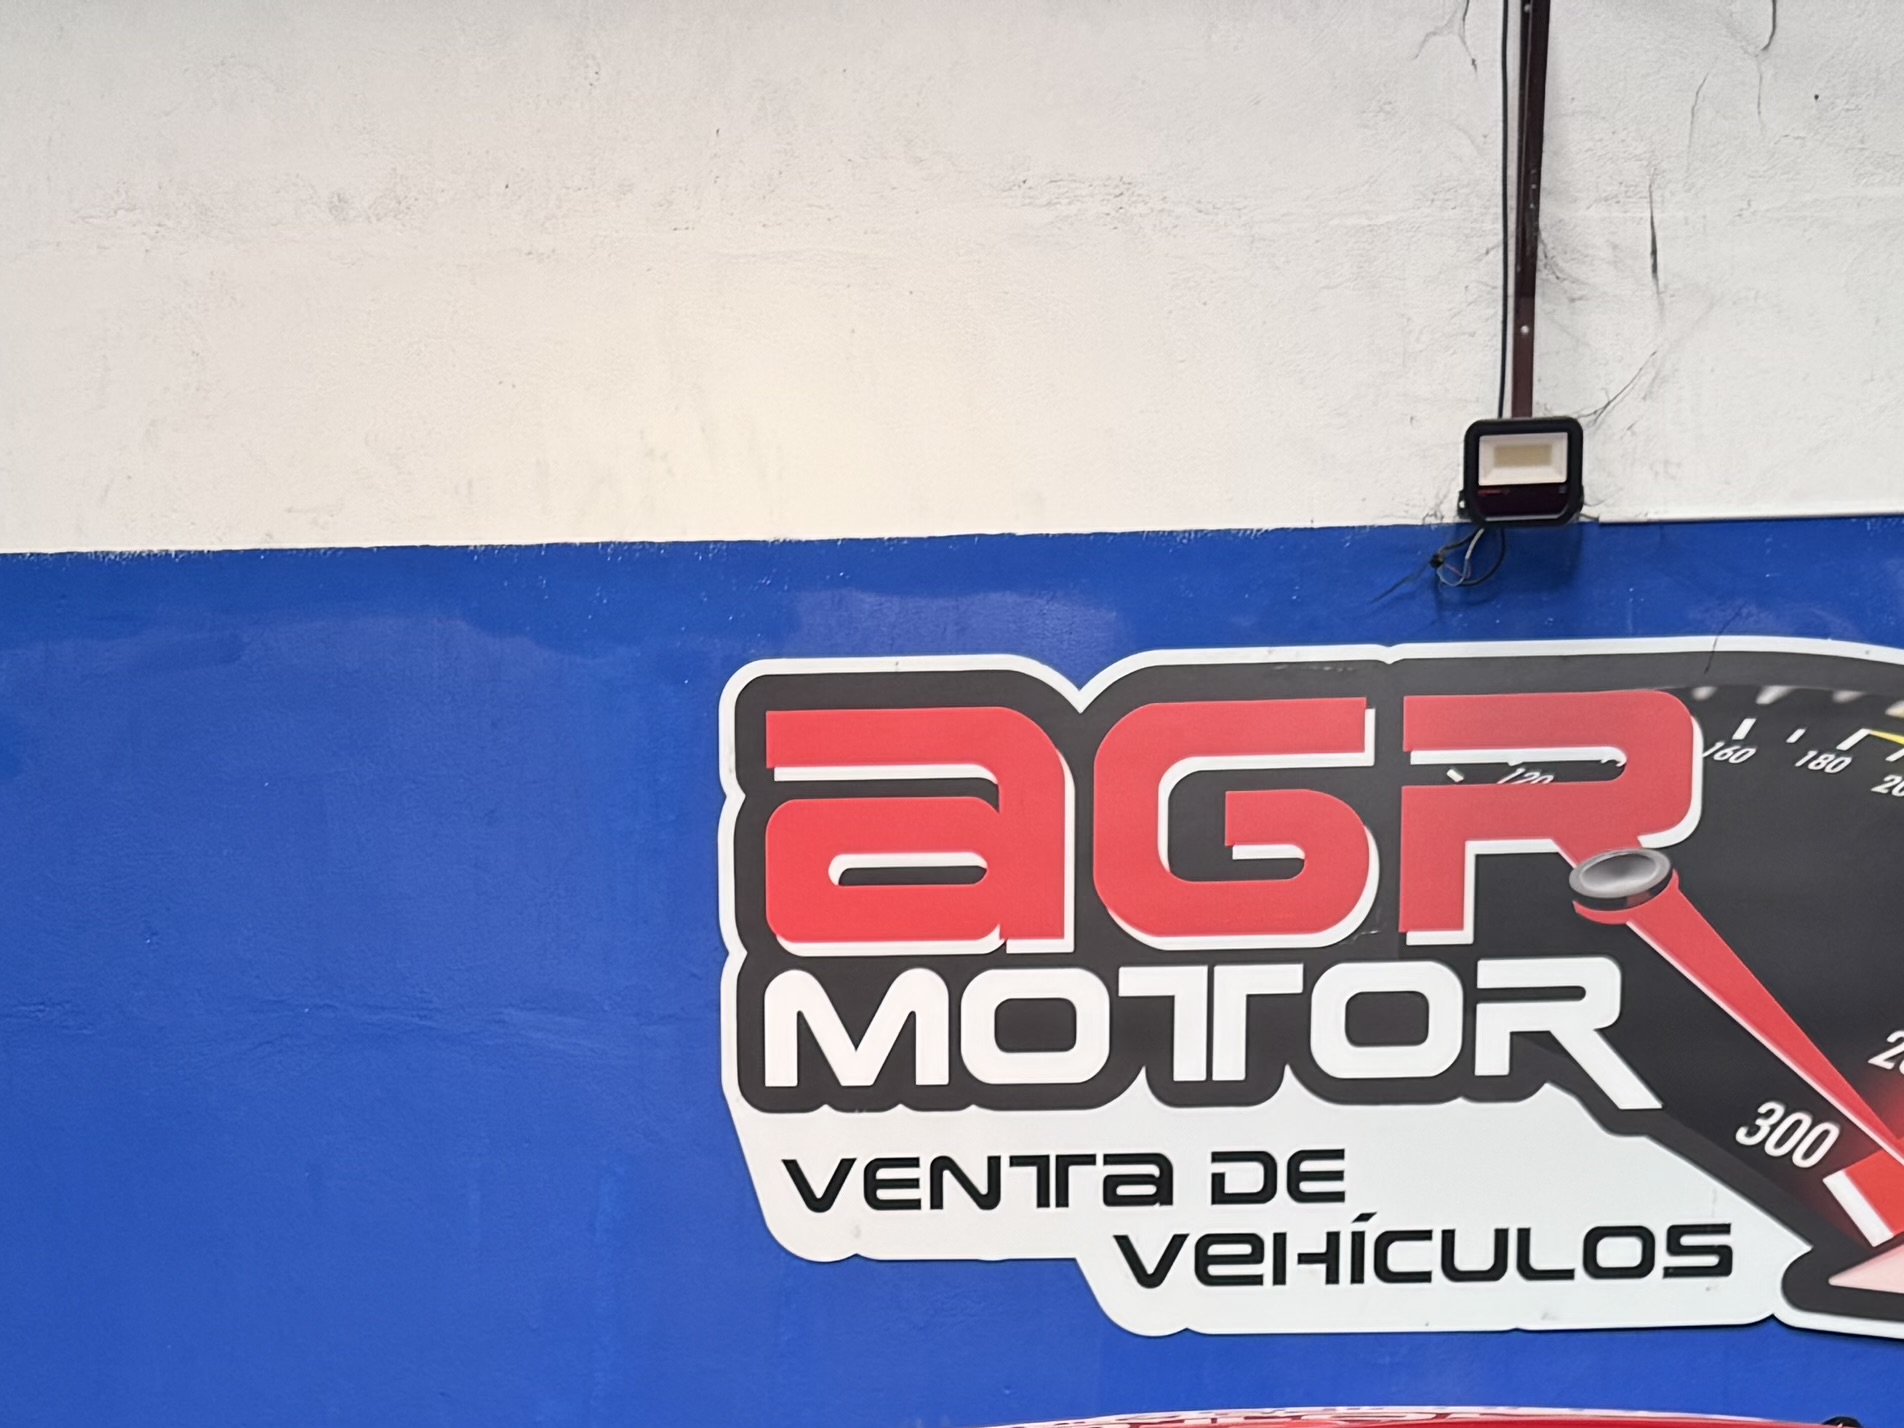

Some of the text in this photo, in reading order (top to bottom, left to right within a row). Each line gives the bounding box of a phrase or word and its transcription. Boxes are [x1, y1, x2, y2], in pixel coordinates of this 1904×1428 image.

[1702, 741, 1756, 764] 160
[1794, 750, 1852, 774] 180
[765, 957, 1662, 1109] MOTOR
[1735, 1100, 1840, 1168] 300
[1211, 1149, 1345, 1206] DE
